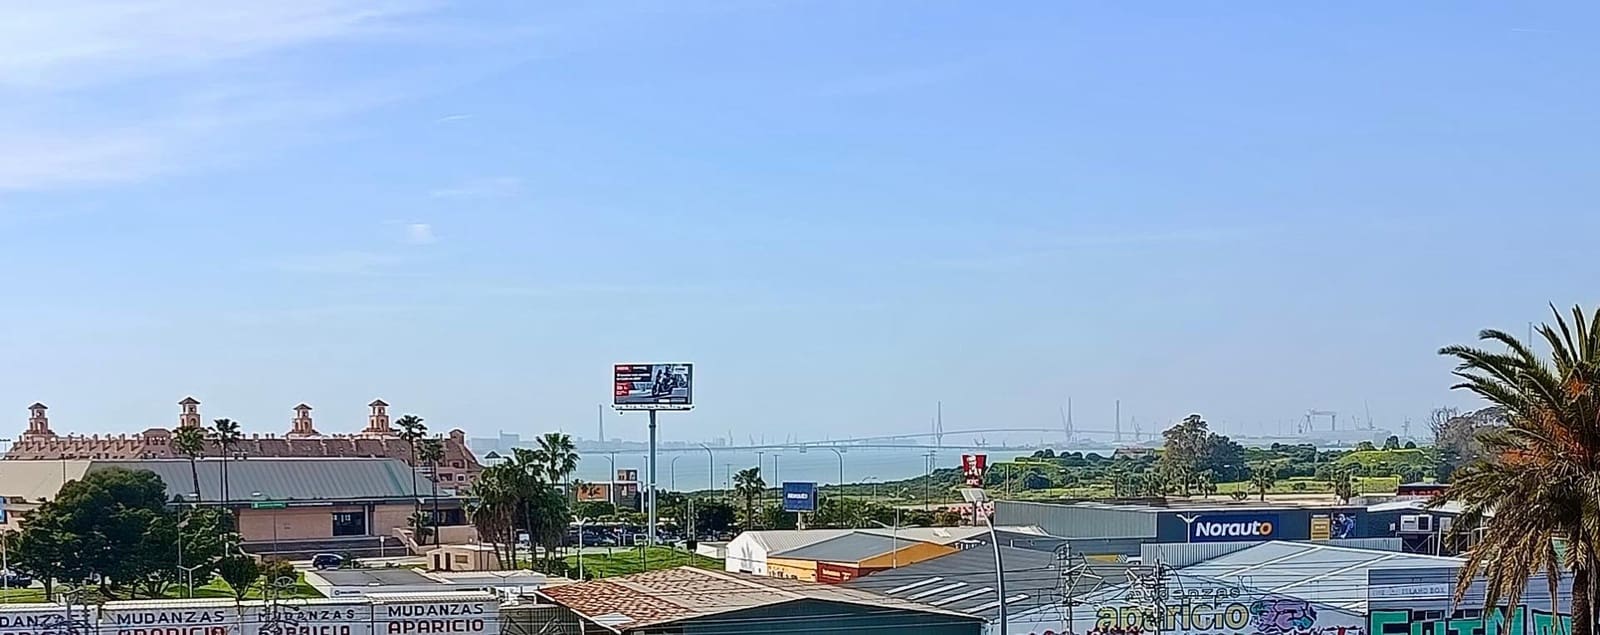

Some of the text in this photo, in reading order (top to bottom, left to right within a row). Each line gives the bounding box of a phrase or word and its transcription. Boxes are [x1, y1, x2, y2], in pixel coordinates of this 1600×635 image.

[1195, 520, 1273, 537] Norauto
[117, 610, 225, 625] MUDANZAS
[388, 603, 484, 617] MUDANZAS
[388, 619, 484, 634] APARICIO
